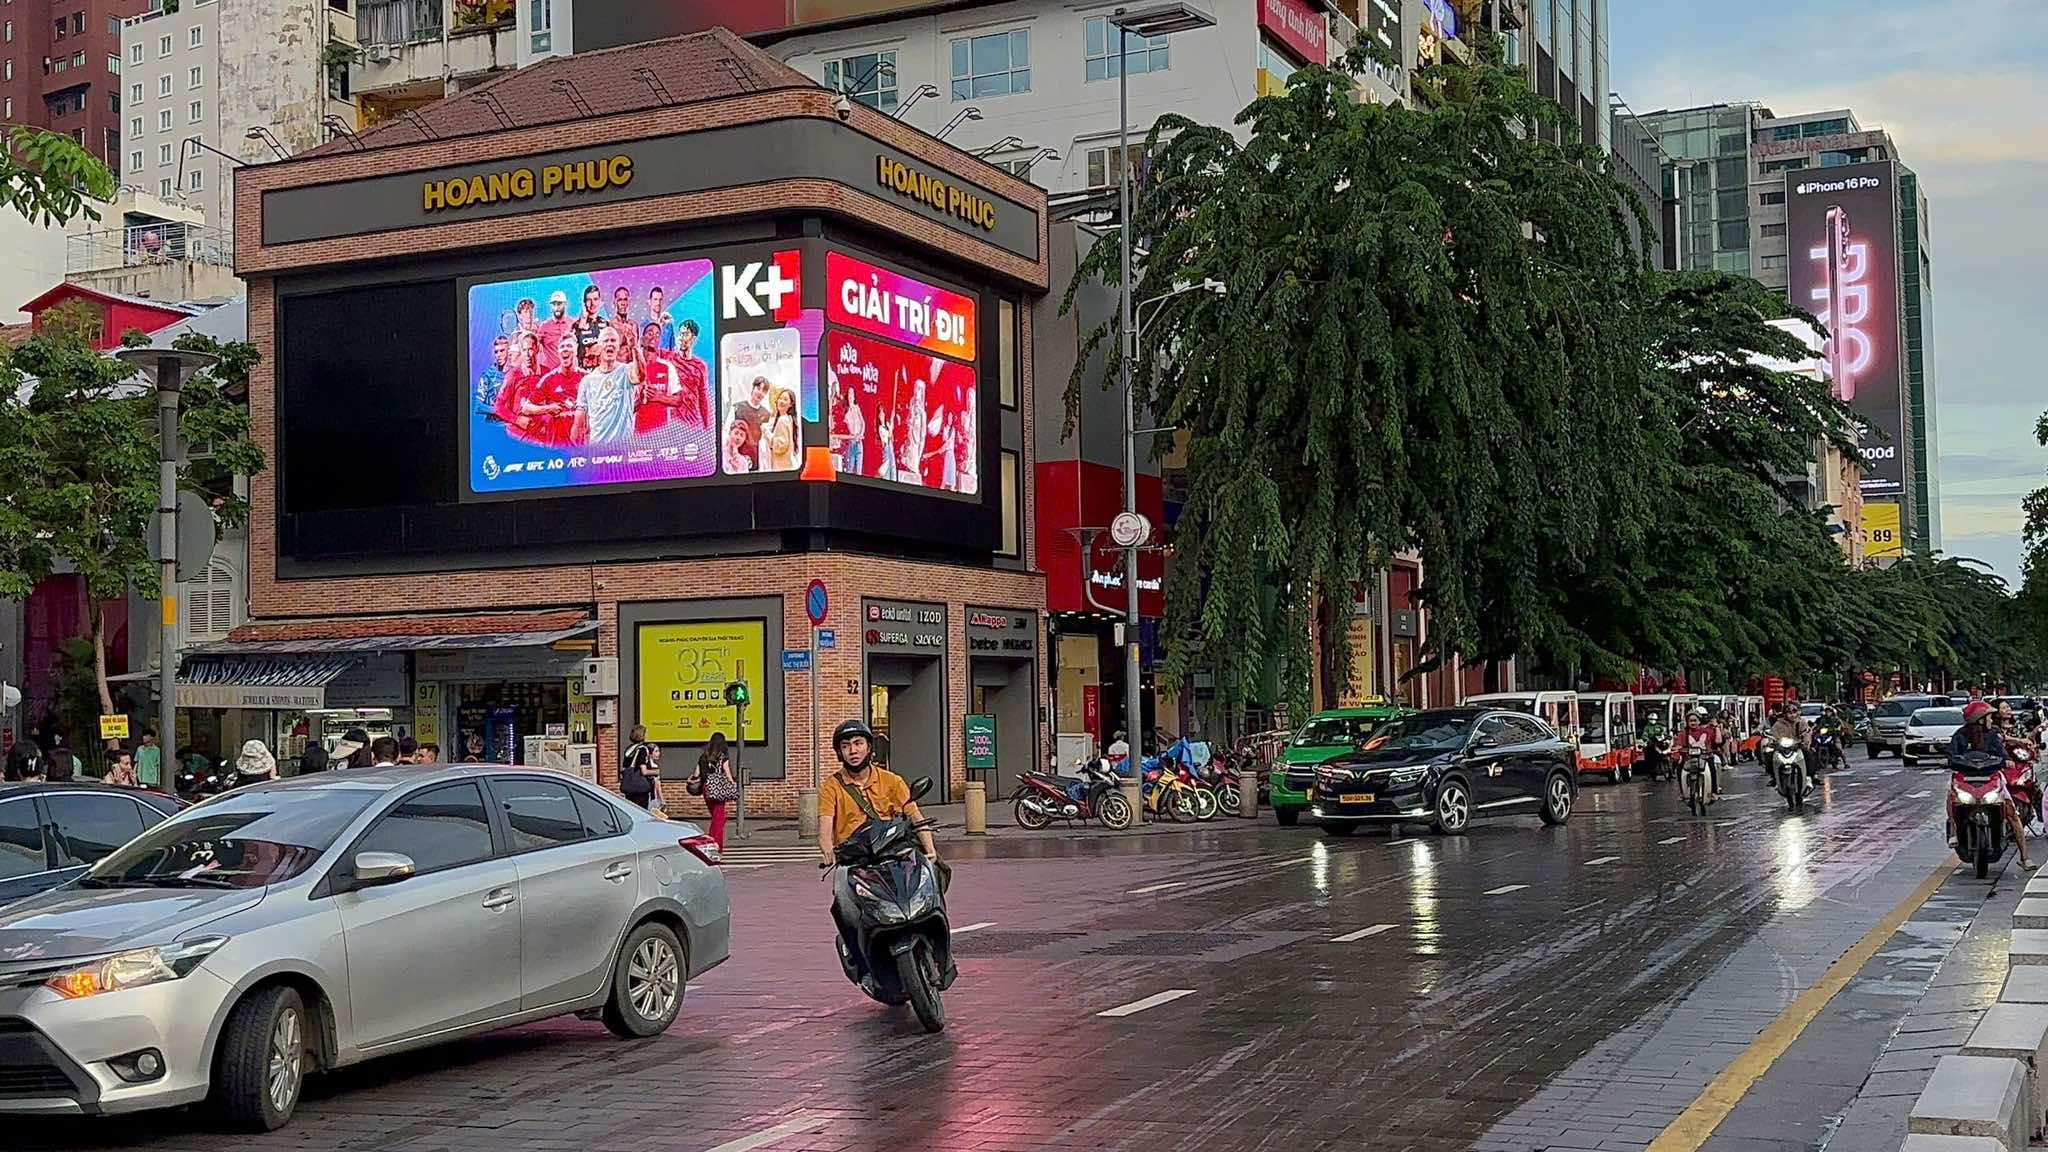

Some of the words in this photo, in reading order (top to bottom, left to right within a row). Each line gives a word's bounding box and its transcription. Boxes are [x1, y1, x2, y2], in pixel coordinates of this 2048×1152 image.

[424, 168, 534, 210] HOANG
[542, 154, 632, 195] PHUC
[1806, 181, 1845, 194] iPhone
[1846, 178, 1859, 190] 16
[1860, 177, 1880, 188] Pro
[879, 156, 945, 210] HOANG
[948, 186, 994, 230] PHUC
[721, 262, 794, 319] K+
[841, 273, 890, 325] GIẢI
[895, 296, 932, 337] TRÍ
[935, 308, 966, 347] ĐI!
[526, 460, 546, 471] UFC
[1872, 529, 1892, 542] 89
[919, 610, 943, 623] IZOD
[980, 613, 1007, 630] Kappa
[879, 631, 909, 644] SUPERGA
[420, 685, 436, 700] 97
[572, 681, 585, 696] 9
[847, 679, 859, 694] 52
